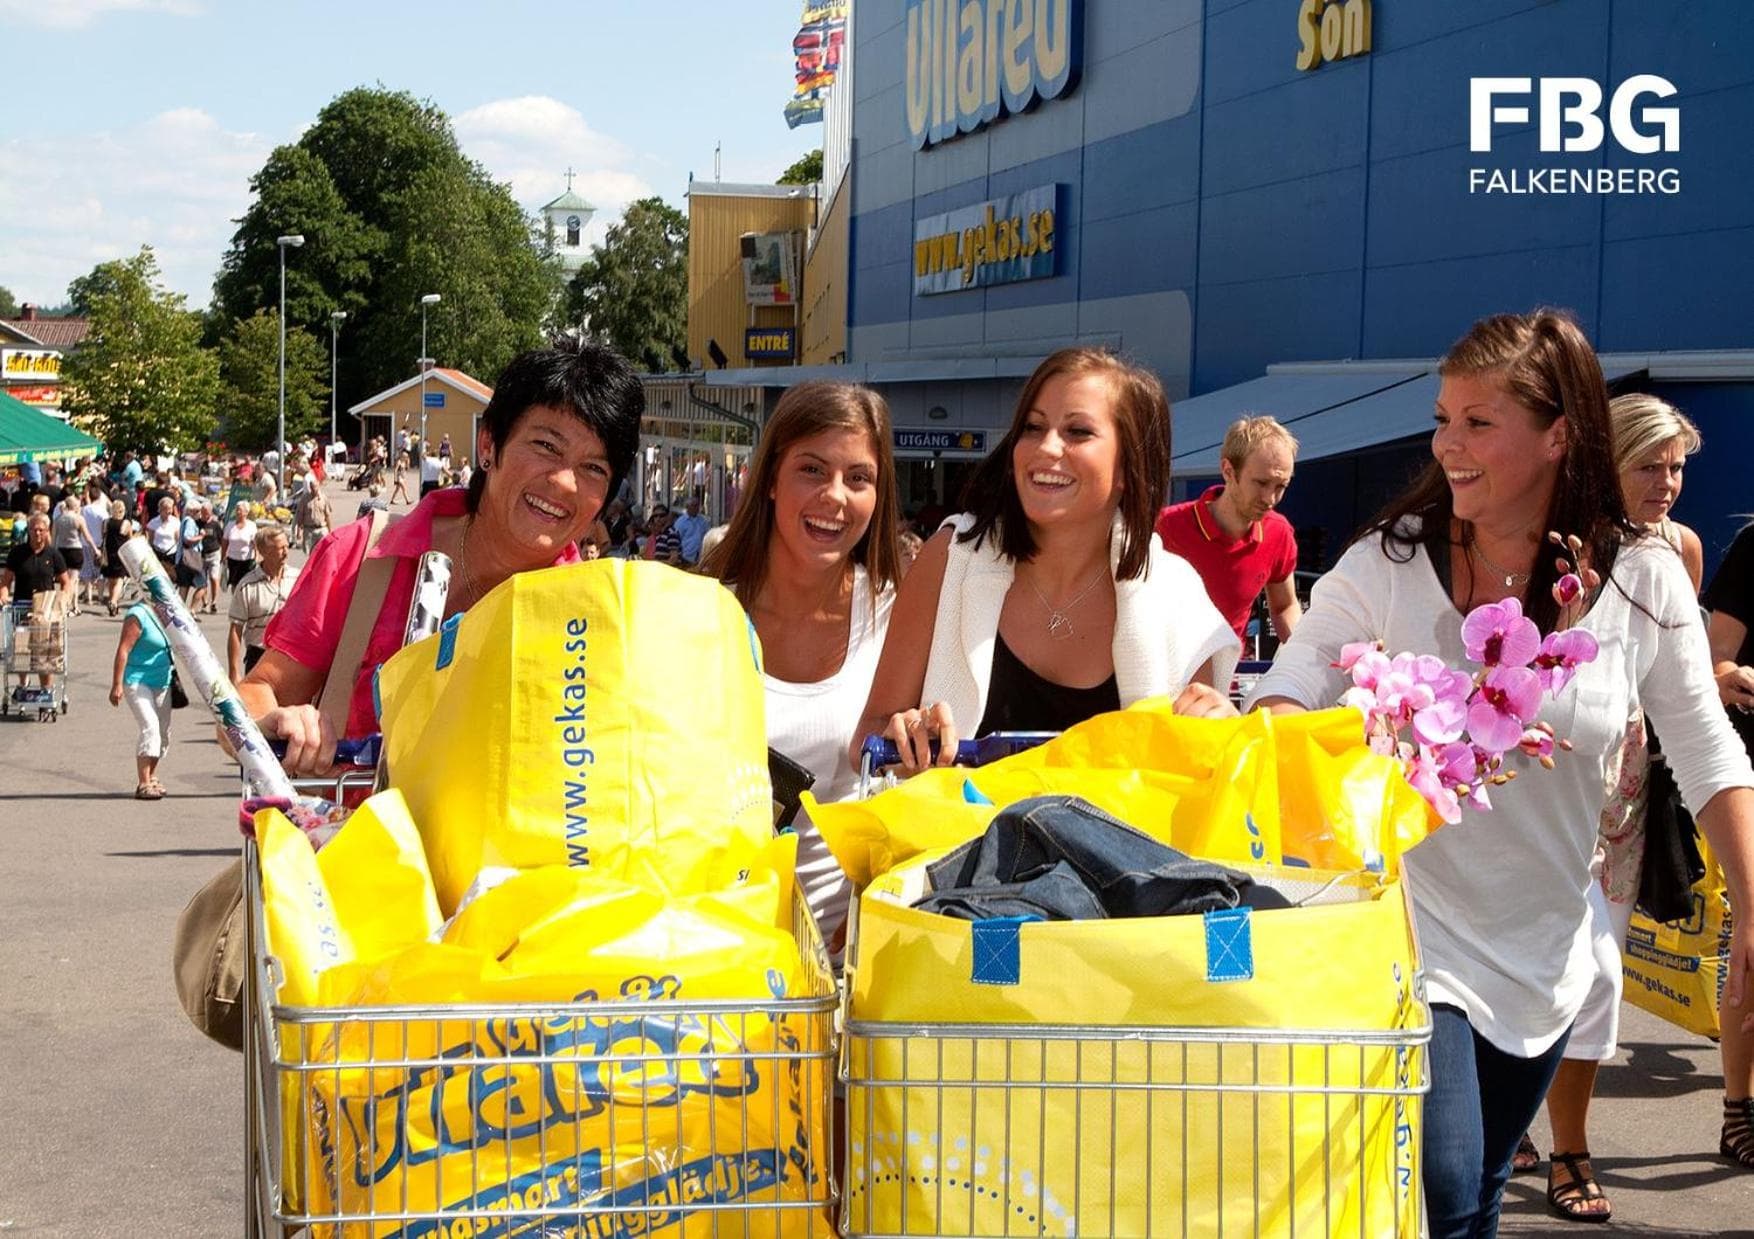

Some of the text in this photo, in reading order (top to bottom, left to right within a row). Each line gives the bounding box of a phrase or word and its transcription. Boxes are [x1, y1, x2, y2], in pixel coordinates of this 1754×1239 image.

[915, 203, 1055, 284] www.gekas.se
[748, 331, 790, 351] ENTRÉ
[900, 432, 949, 446] UTGÅNG
[554, 618, 595, 869] www.gekas.se
